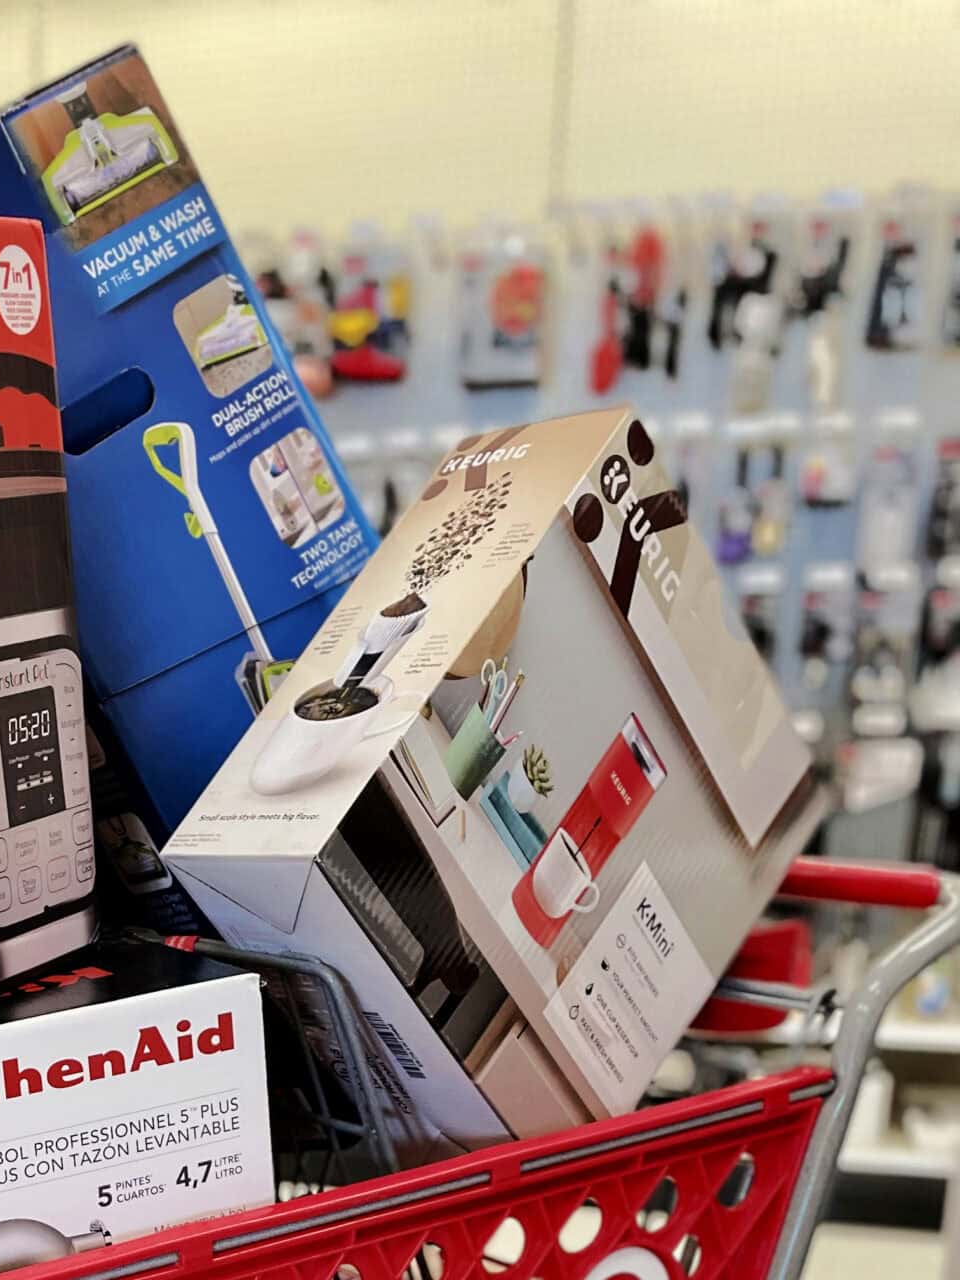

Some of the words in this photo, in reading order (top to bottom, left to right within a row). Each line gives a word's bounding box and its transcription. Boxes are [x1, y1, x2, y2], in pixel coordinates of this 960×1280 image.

[82, 231, 149, 279] VACUUM
[148, 224, 162, 242] &
[158, 196, 207, 233] WASH
[97, 280, 110, 297] AT
[110, 267, 133, 287] THE
[132, 239, 178, 277] SAME
[175, 216, 216, 249] TIME
[211, 370, 288, 428] DUAL-ACTION
[224, 398, 266, 437] BRUSH
[264, 385, 295, 412] ROLL
[441, 443, 532, 474] KEURIG
[299, 538, 329, 565] TWO
[601, 455, 681, 603] KEURIG
[290, 532, 364, 590] TECHNOLOGY
[8, 709, 50, 746] 05:20
[24, 1156, 64, 1179] CON
[70, 1141, 130, 1168] TAZÓN
[135, 1115, 240, 1153] LEVANTABLE
[33, 1113, 176, 1158] PROFESSIONNEL
[200, 1097, 240, 1119] PLUS
[97, 1184, 114, 1208] 5
[175, 1159, 213, 1189] 4,7
[215, 1165, 244, 1180] LITRO
